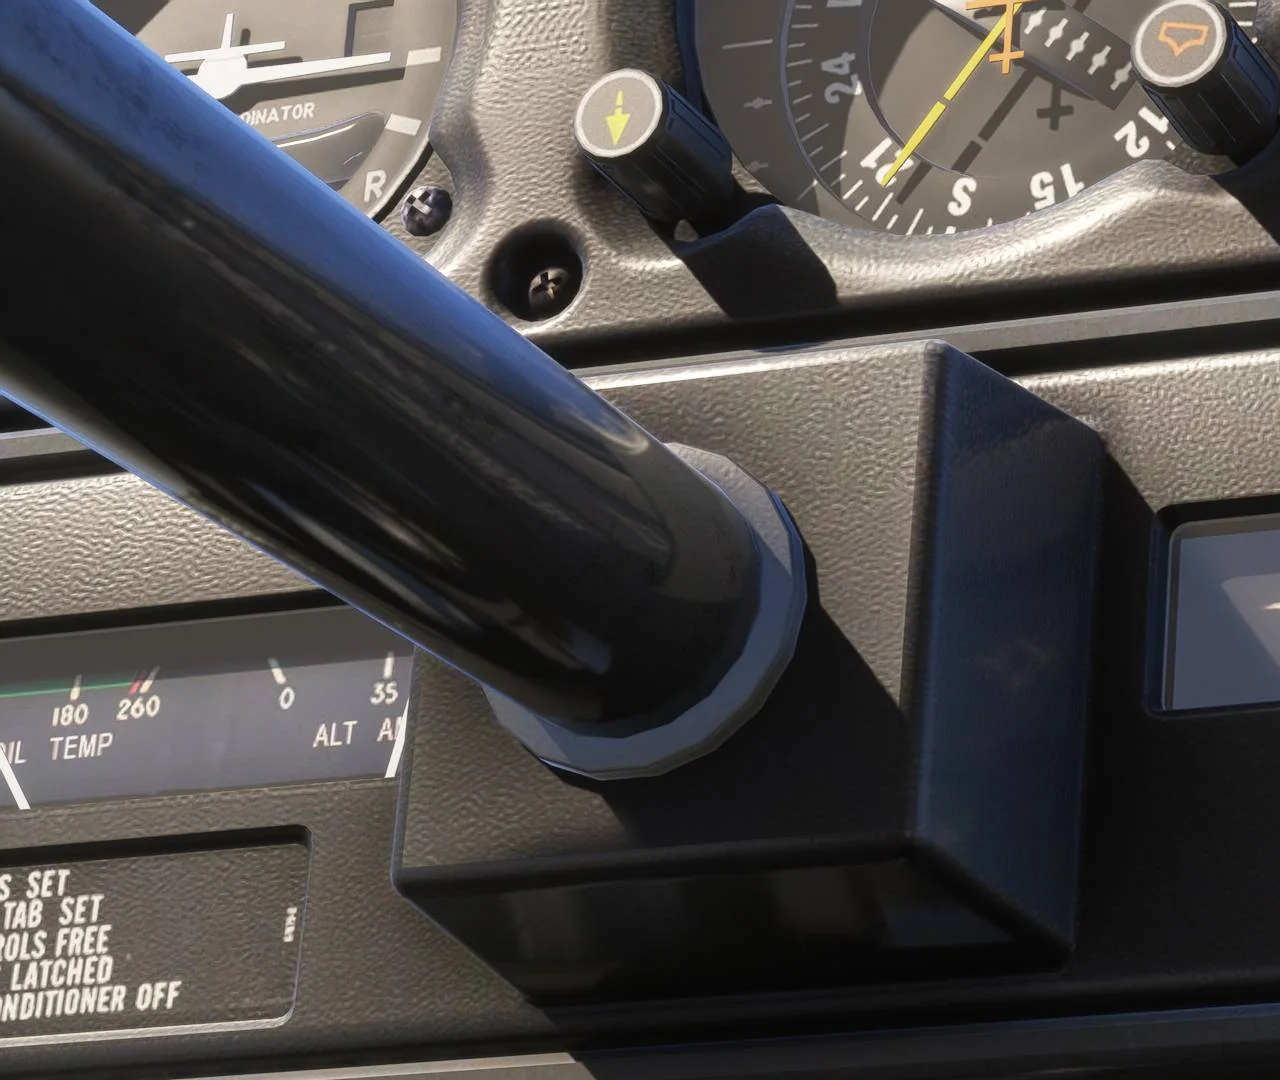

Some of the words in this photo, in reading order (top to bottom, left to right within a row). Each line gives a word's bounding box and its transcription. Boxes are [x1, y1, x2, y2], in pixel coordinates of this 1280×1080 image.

[364, 170, 387, 202] R
[947, 176, 978, 217] S
[1029, 163, 1085, 210] 15
[51, 703, 89, 727] 180
[116, 694, 161, 721] 260
[278, 687, 295, 710] 0
[370, 681, 399, 704] 35
[50, 732, 114, 760] TEMP
[312, 720, 358, 749] ALT
[26, 869, 71, 899] SET
[3, 899, 44, 930] TAB
[58, 893, 105, 926] SET
[55, 924, 113, 958] FREE
[10, 955, 114, 992] LATCHED
[135, 980, 183, 1012] OFF
